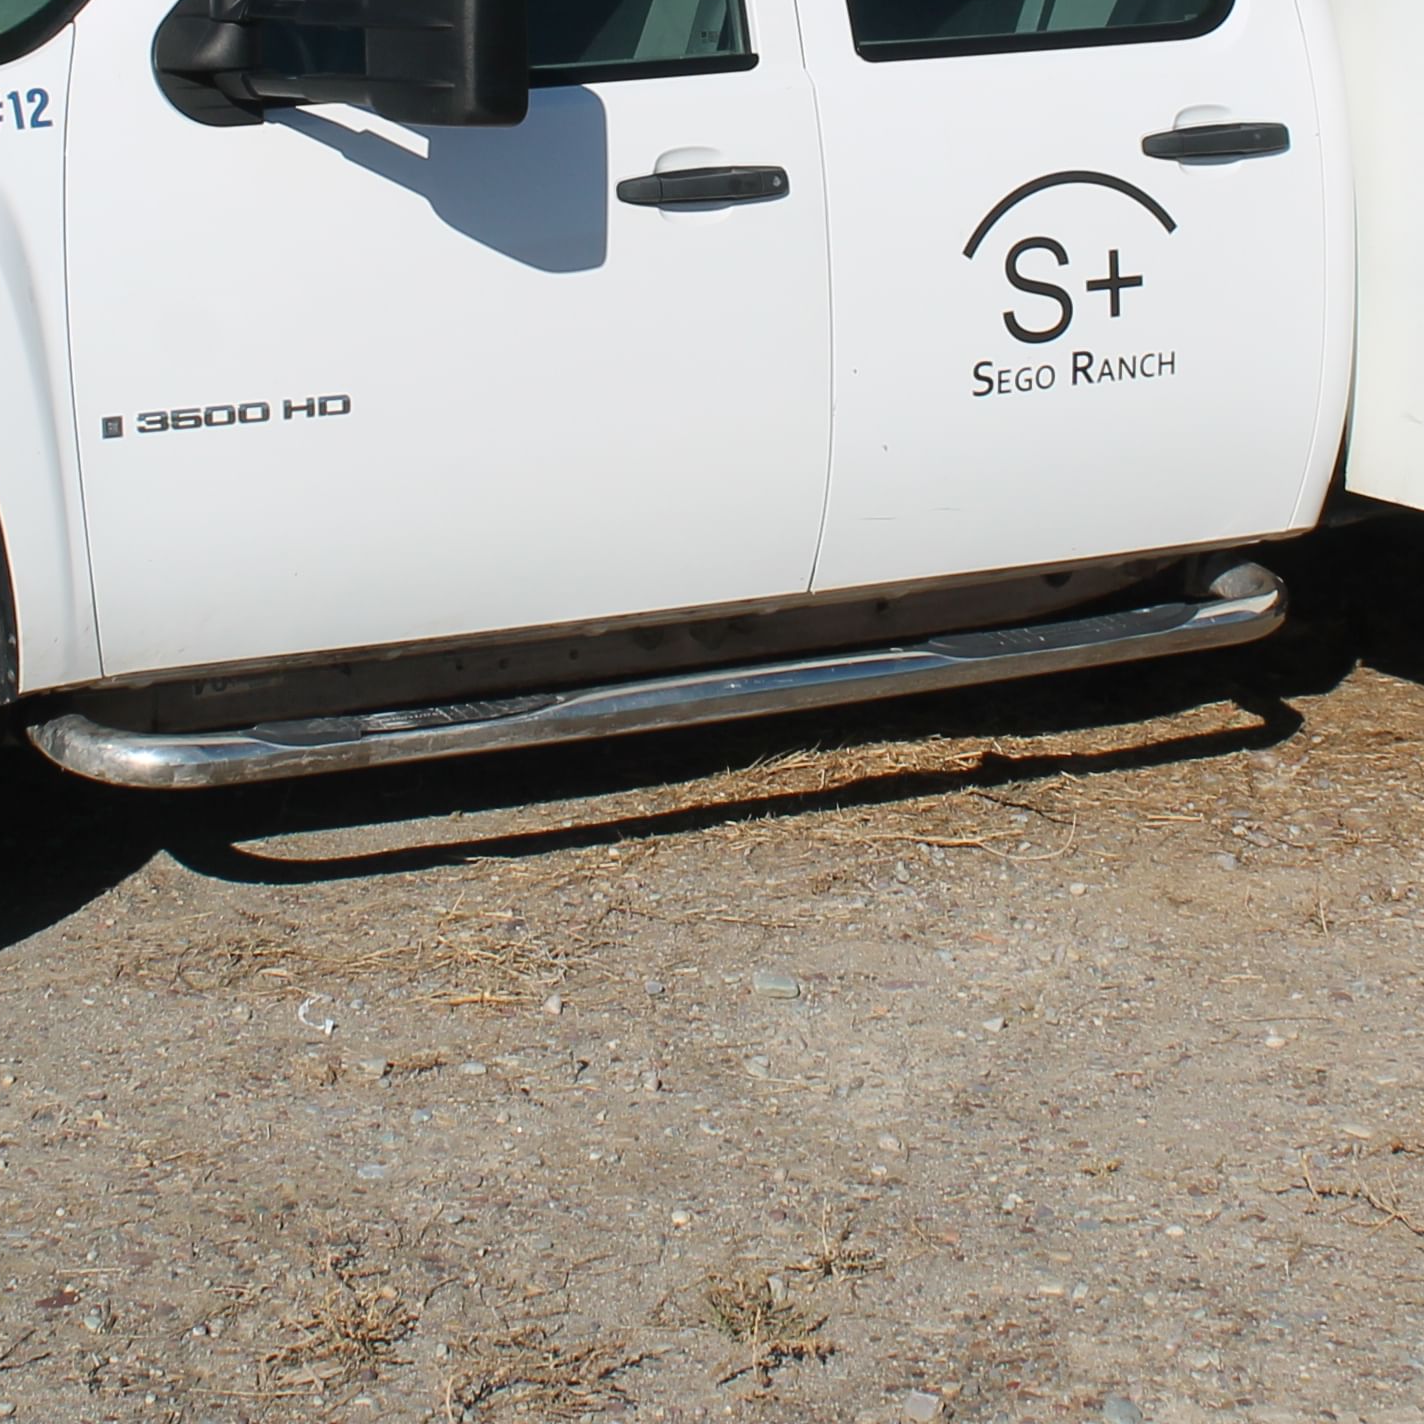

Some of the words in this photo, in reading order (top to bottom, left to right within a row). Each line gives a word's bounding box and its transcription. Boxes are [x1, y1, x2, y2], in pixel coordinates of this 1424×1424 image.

[972, 360, 1056, 397] SEGO
[1071, 350, 1175, 386] RANCH
[137, 401, 271, 434] 3500
[283, 394, 351, 420] HD
